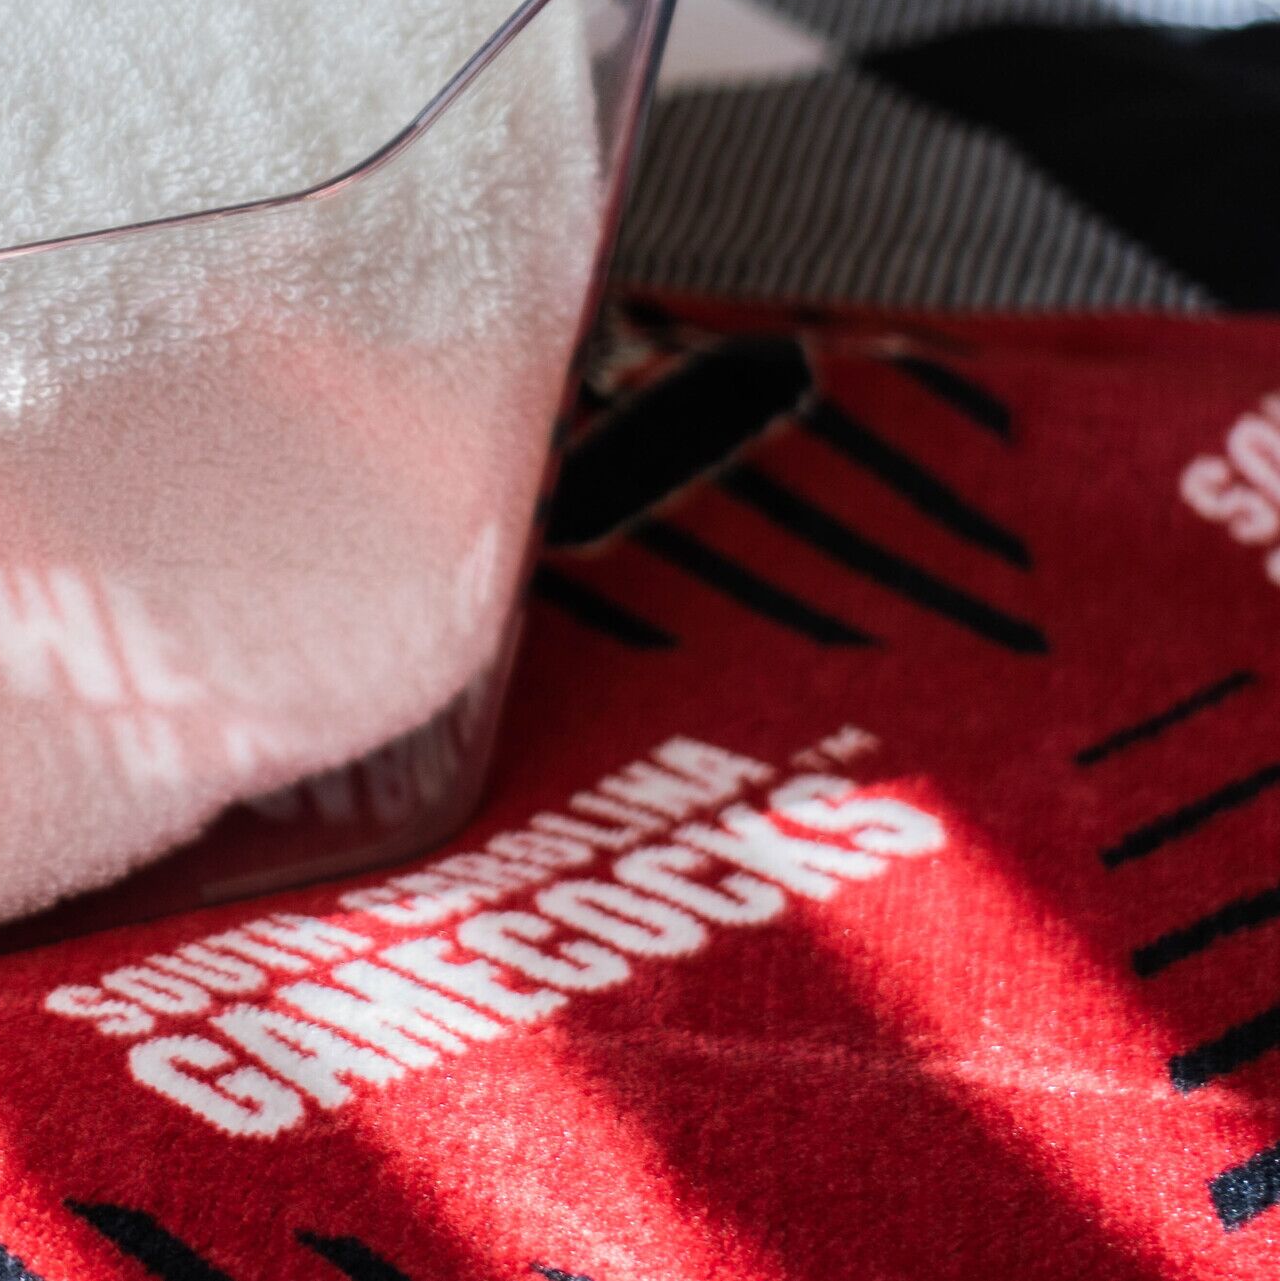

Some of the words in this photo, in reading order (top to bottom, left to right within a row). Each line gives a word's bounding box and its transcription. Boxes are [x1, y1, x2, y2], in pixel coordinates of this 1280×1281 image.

[44, 913, 375, 1039] SOUTH
[340, 733, 776, 926] CAROLINA
[127, 772, 949, 1141] GAMECOCKS
